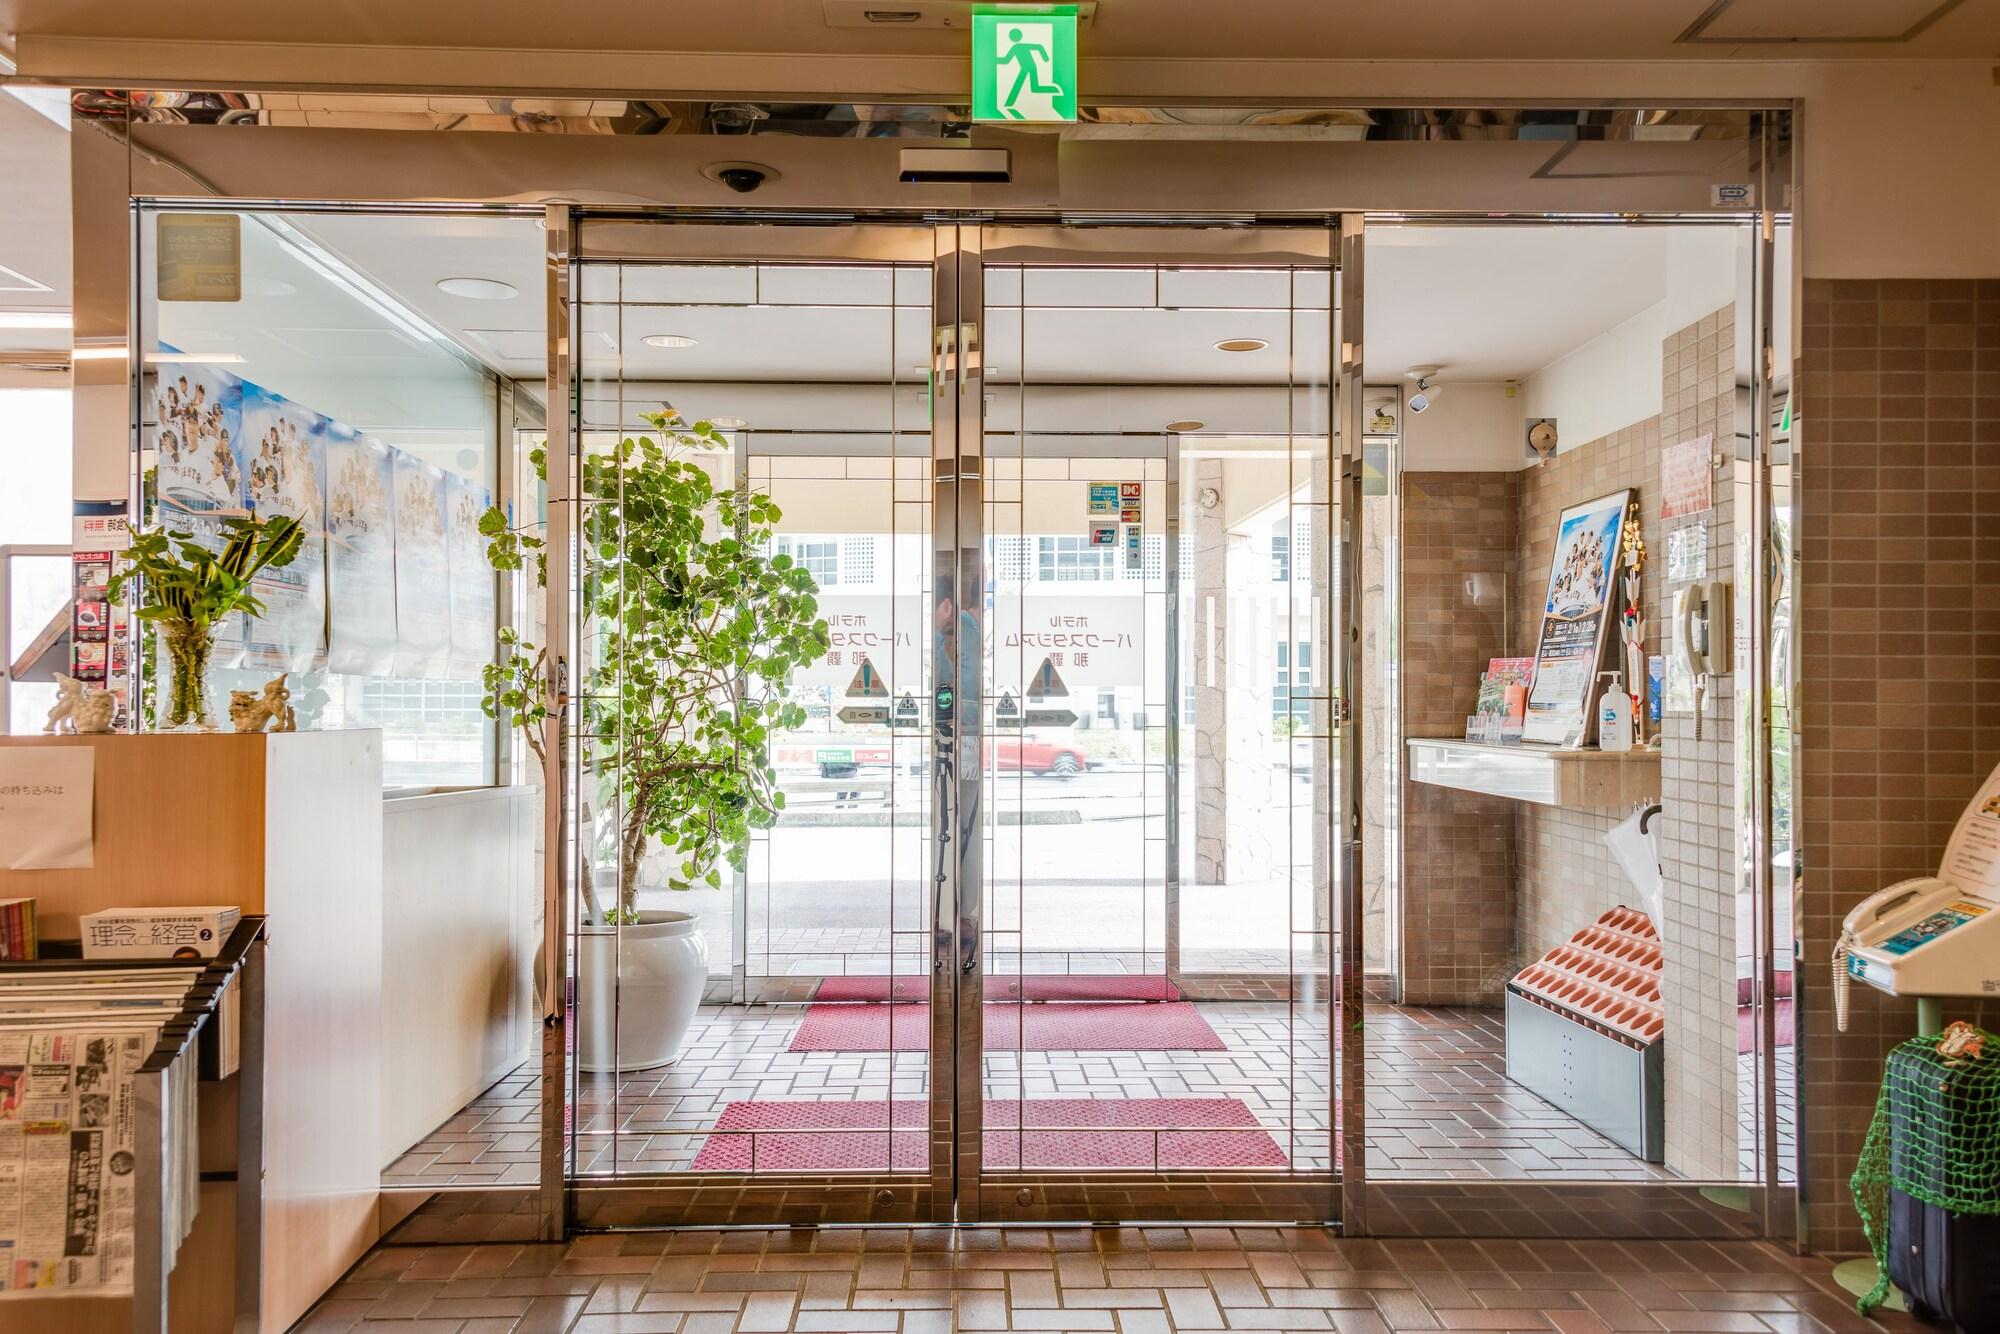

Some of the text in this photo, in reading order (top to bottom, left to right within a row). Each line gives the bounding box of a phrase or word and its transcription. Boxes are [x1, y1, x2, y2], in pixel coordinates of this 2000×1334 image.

[0, 784, 64, 796] の持ち込みは
